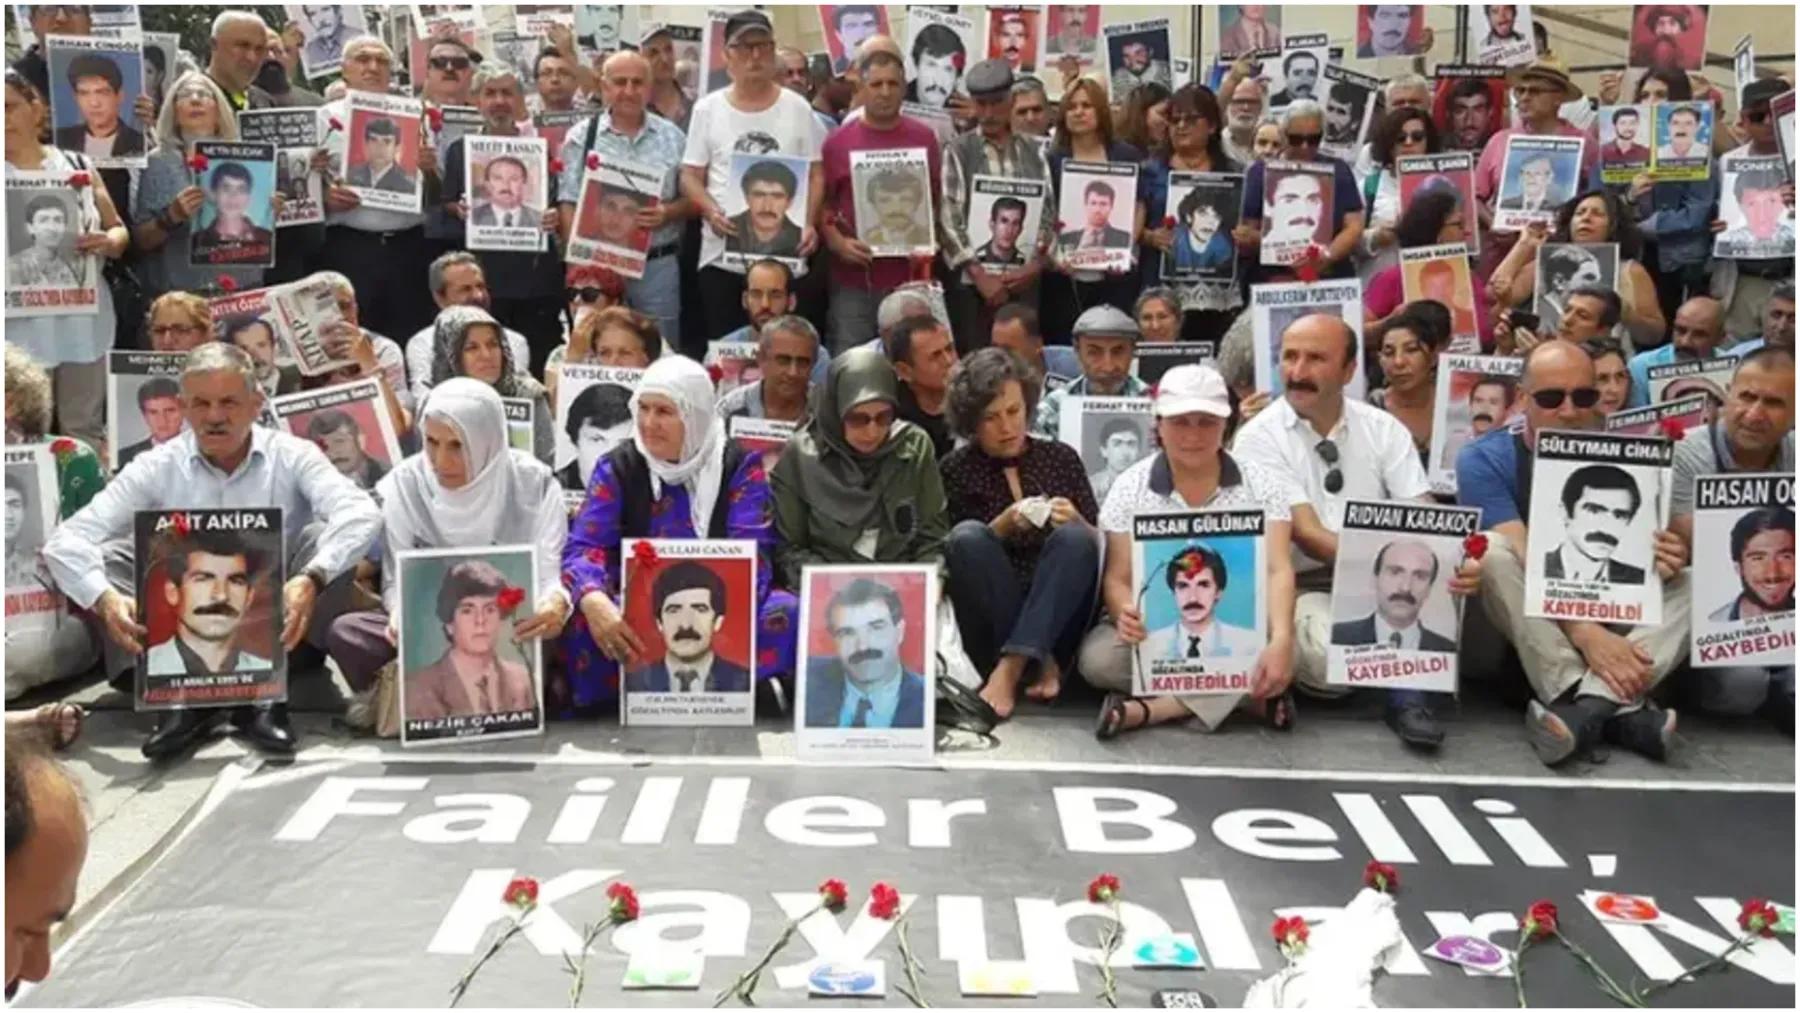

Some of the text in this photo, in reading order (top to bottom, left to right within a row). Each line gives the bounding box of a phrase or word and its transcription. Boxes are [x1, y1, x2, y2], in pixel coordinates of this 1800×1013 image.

[50, 39, 92, 49] ORHAN
[5, 179, 47, 188] FERHAT
[563, 367, 643, 382] VEYSEL GÜN
[1488, 361, 1523, 374] ALPS
[1083, 402, 1122, 411] FERHAT
[1540, 437, 1620, 458] SÜLEYMAN
[1700, 480, 1769, 506] HASAN
[155, 510, 269, 532] AİT AKİPA
[1136, 513, 1262, 536] HASAN GÜLÜNAY
[1346, 503, 1403, 528] RIDVAN
[702, 545, 743, 556] CANAN
[1542, 599, 1642, 621] KAYBEDİLDİ
[1695, 624, 1772, 647] GÖZALTINDA
[1347, 654, 1449, 682] KAYBEDİLDİ
[1151, 670, 1249, 691] KAYBEDİLDİ
[409, 711, 534, 731] NEZİR ÇAKAR
[274, 775, 1618, 877] Failler Belli,
